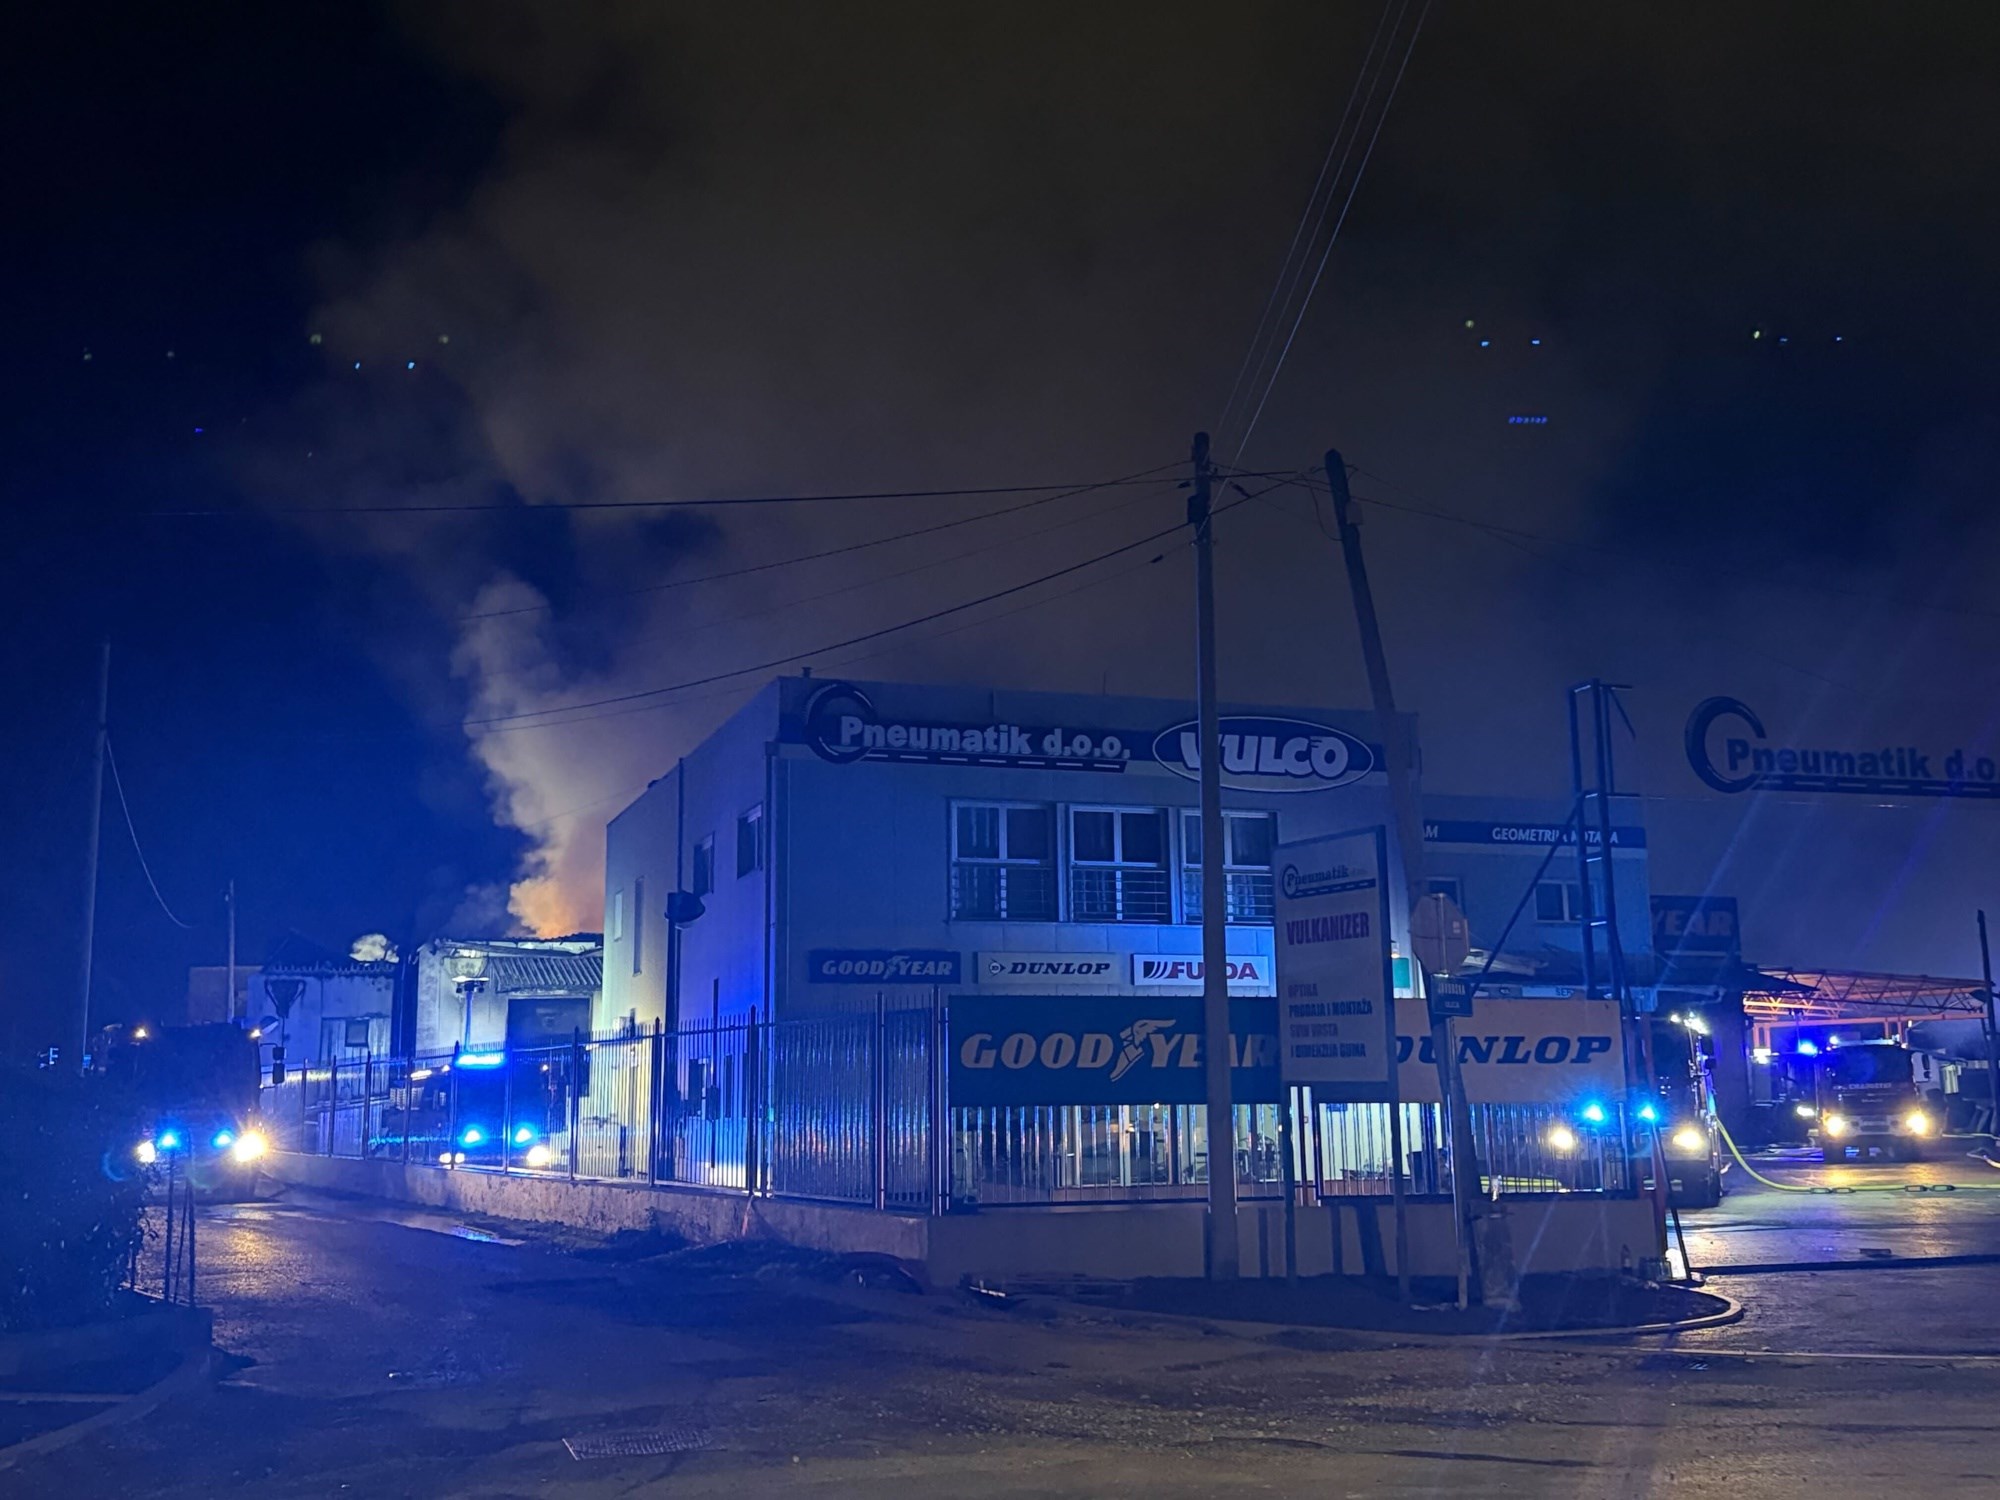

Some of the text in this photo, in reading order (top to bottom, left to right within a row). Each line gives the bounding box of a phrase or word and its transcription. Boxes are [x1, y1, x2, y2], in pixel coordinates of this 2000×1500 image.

[841, 716, 1131, 759] Pneumatik d.o.o.
[1179, 731, 1349, 778] VULCO
[1727, 738, 1931, 778] Pneumatik
[1286, 864, 1350, 887] Pneumatik
[1286, 912, 1370, 945] VULKANIZER
[1008, 962, 1111, 976] DUNLOP
[1165, 961, 1259, 980] FUDA
